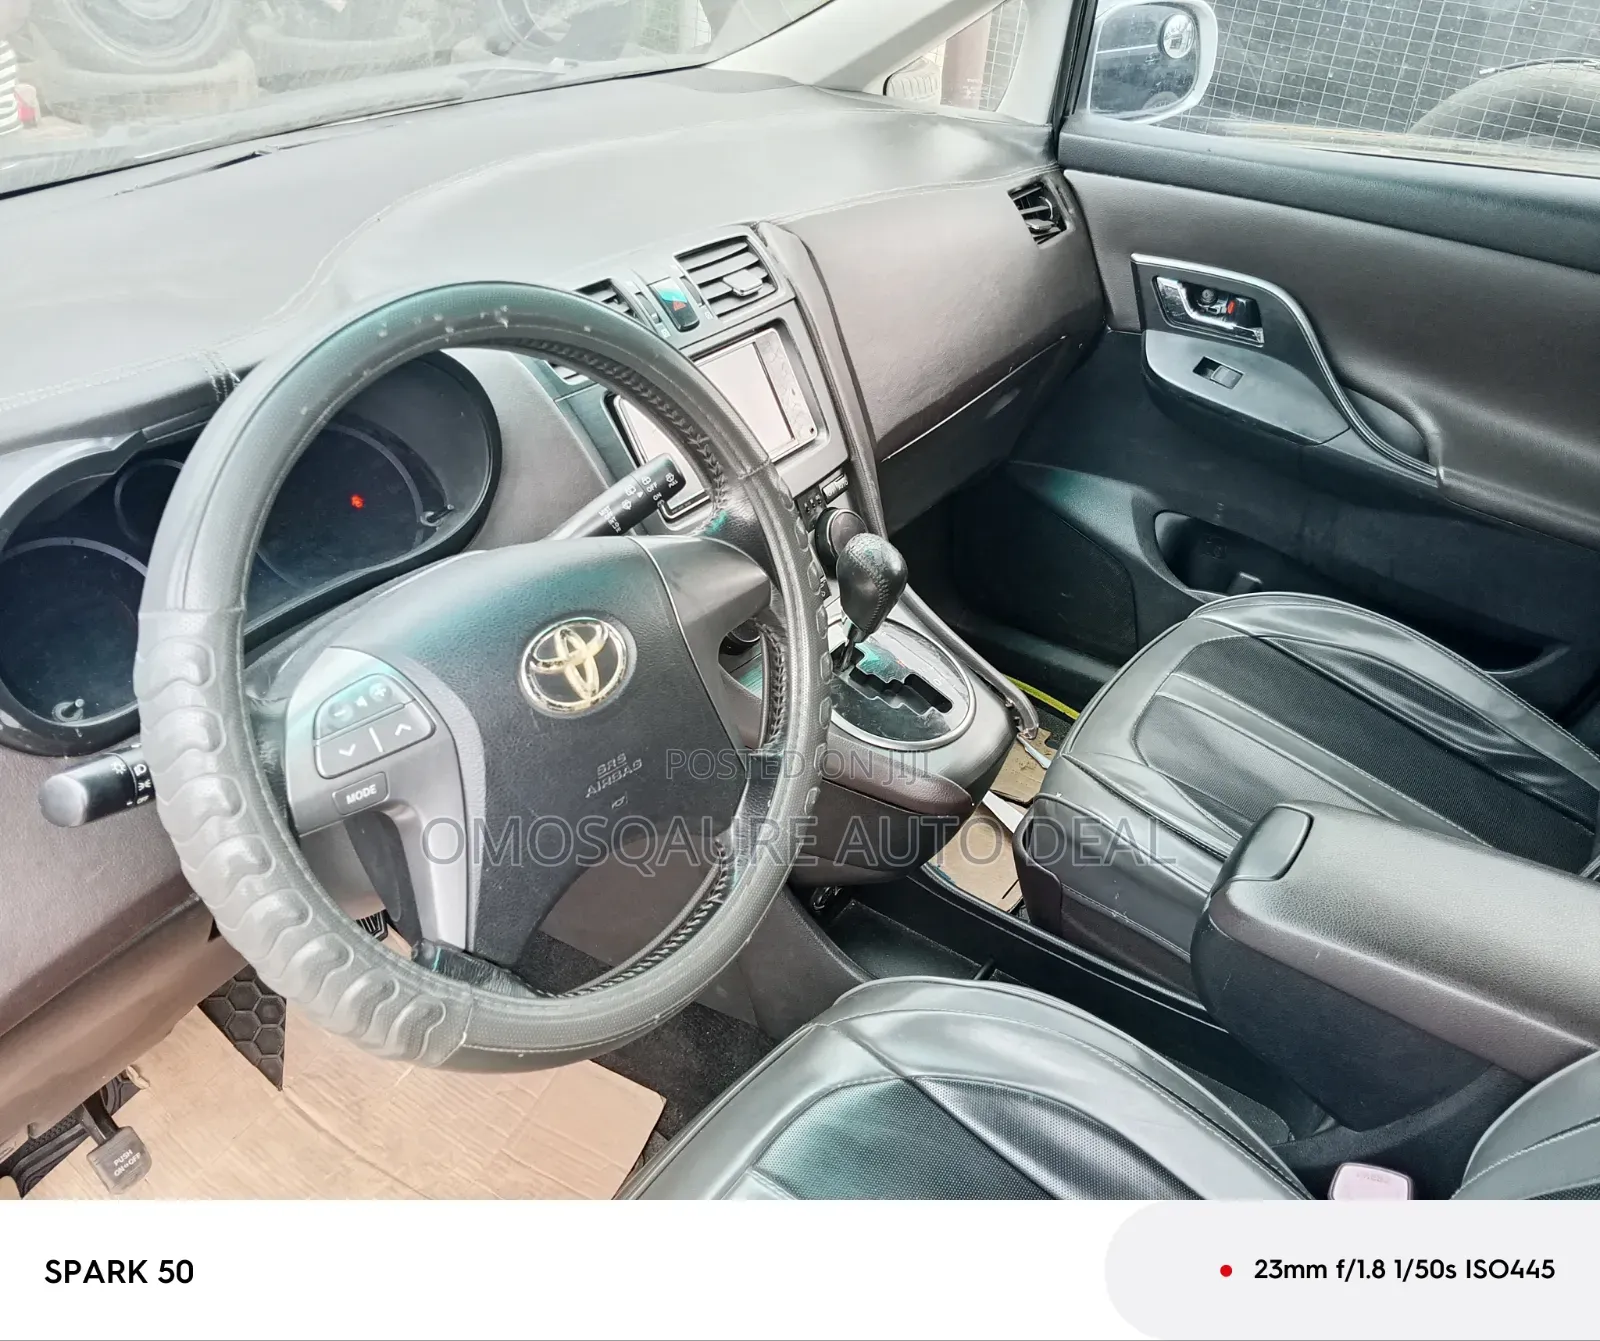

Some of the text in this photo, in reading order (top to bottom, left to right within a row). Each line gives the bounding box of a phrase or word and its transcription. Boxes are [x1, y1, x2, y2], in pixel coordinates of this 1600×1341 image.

[646, 481, 658, 492] OFF
[653, 492, 662, 501] ON
[597, 752, 627, 777] SRS
[585, 758, 643, 798] AIRBAG
[136, 795, 149, 804] OFF
[346, 784, 377, 804] MODE
[113, 1149, 133, 1167] PUSH
[114, 1152, 141, 1177] ON OFF
